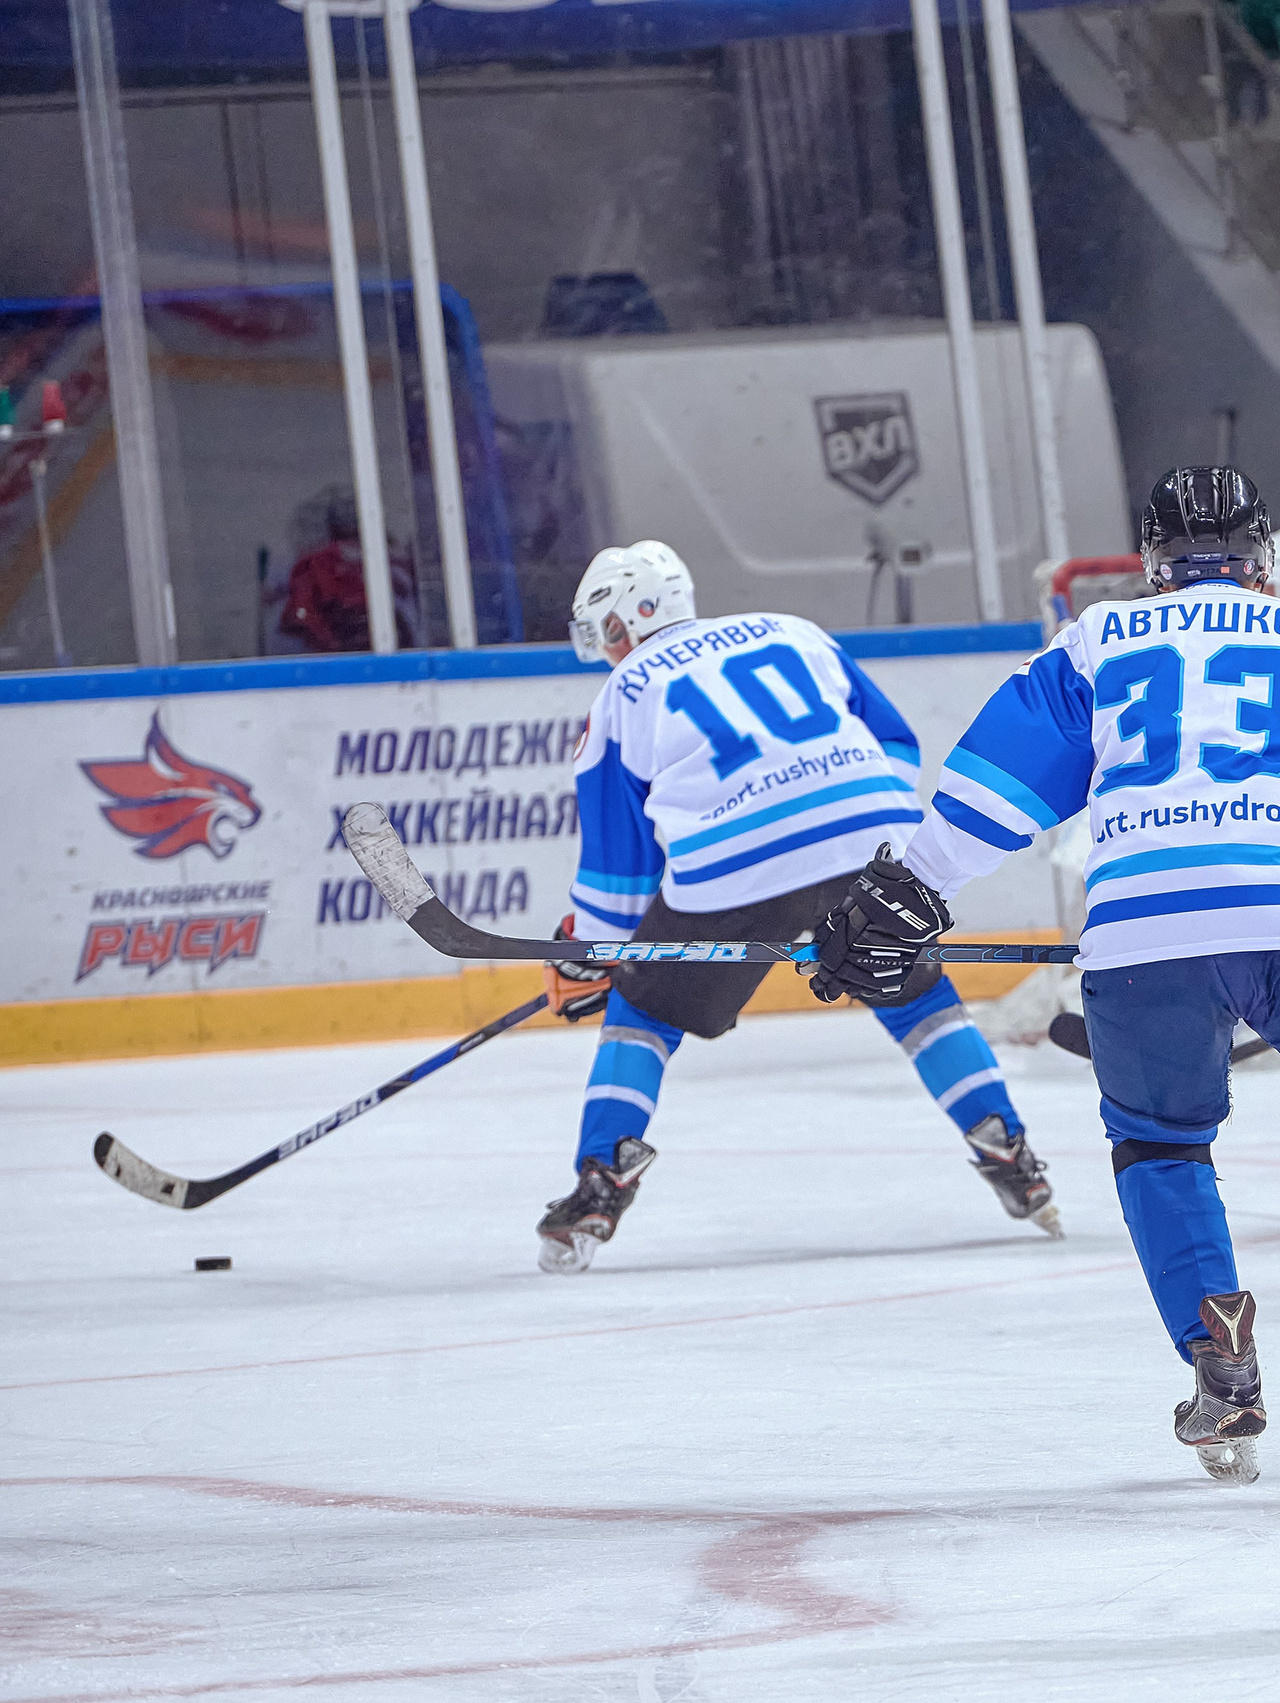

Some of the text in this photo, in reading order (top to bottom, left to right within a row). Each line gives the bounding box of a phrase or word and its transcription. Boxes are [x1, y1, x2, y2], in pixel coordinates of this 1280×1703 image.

[665, 643, 841, 780] 10
[335, 715, 586, 779] МОЛОДЕЖН
[327, 787, 579, 851] ХККЕЙНАЯ
[91, 880, 273, 910] КРАСНОЯРСКИЕ
[317, 867, 529, 926] КОНДА
[854, 875, 931, 931] RUE
[74, 911, 266, 984] РЫСИ
